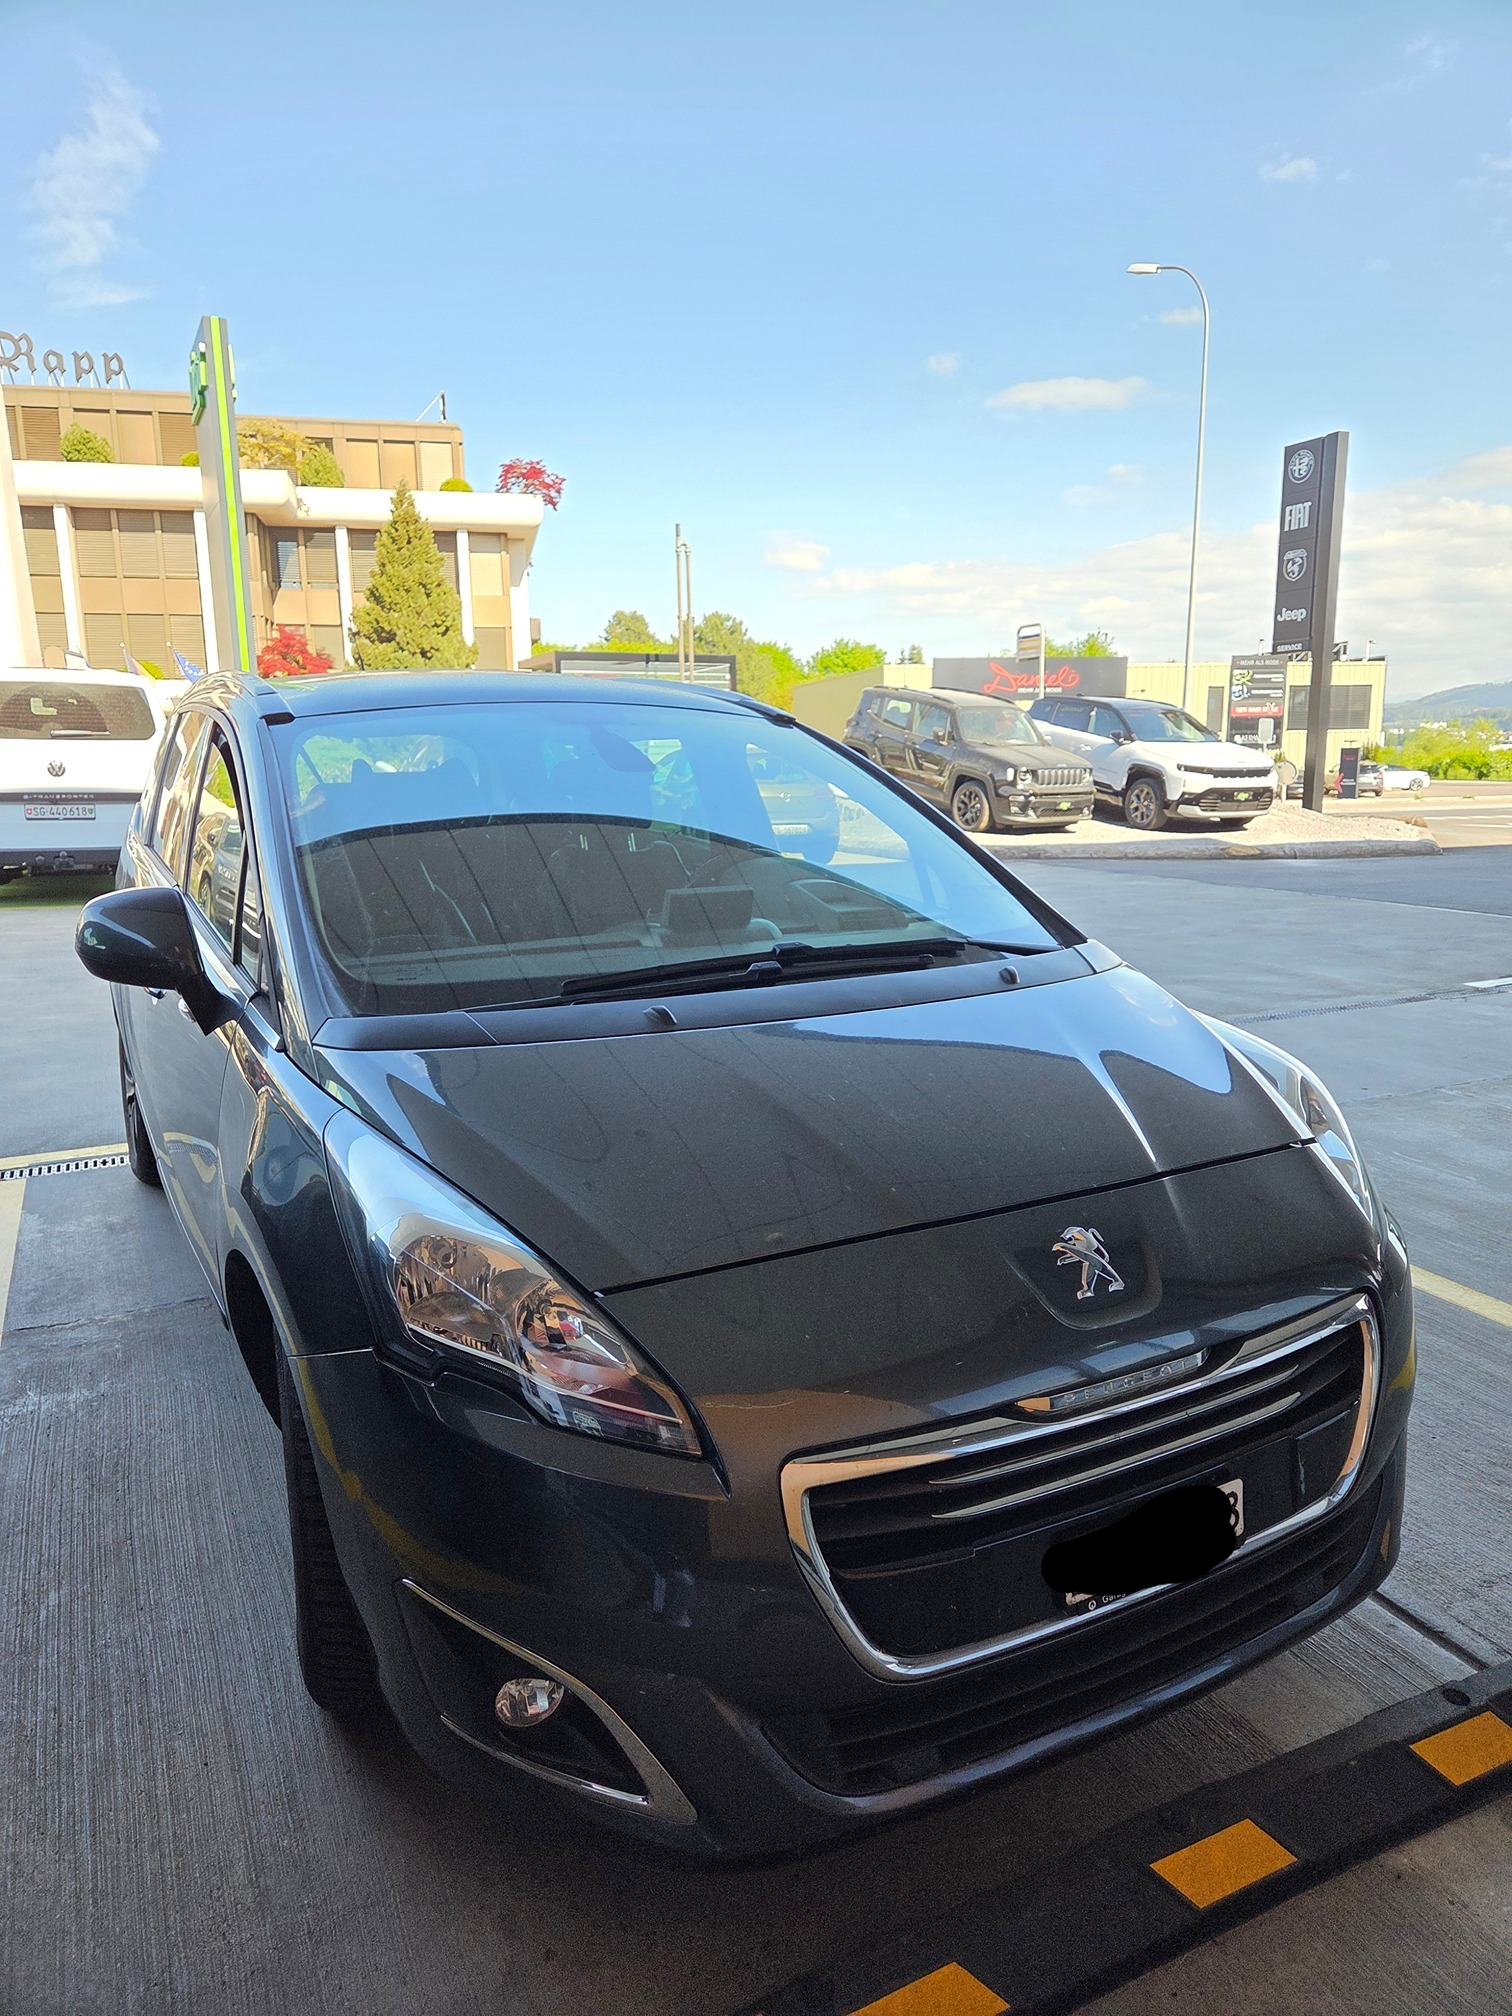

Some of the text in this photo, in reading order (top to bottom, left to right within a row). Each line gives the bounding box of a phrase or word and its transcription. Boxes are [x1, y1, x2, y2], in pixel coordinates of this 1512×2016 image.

[0, 331, 124, 384] Rapp
[1284, 501, 1312, 532] FIAT
[1277, 607, 1307, 622] Jeep
[1277, 643, 1303, 653] SERVICE
[1064, 1360, 1187, 1406] PEUGEOT
